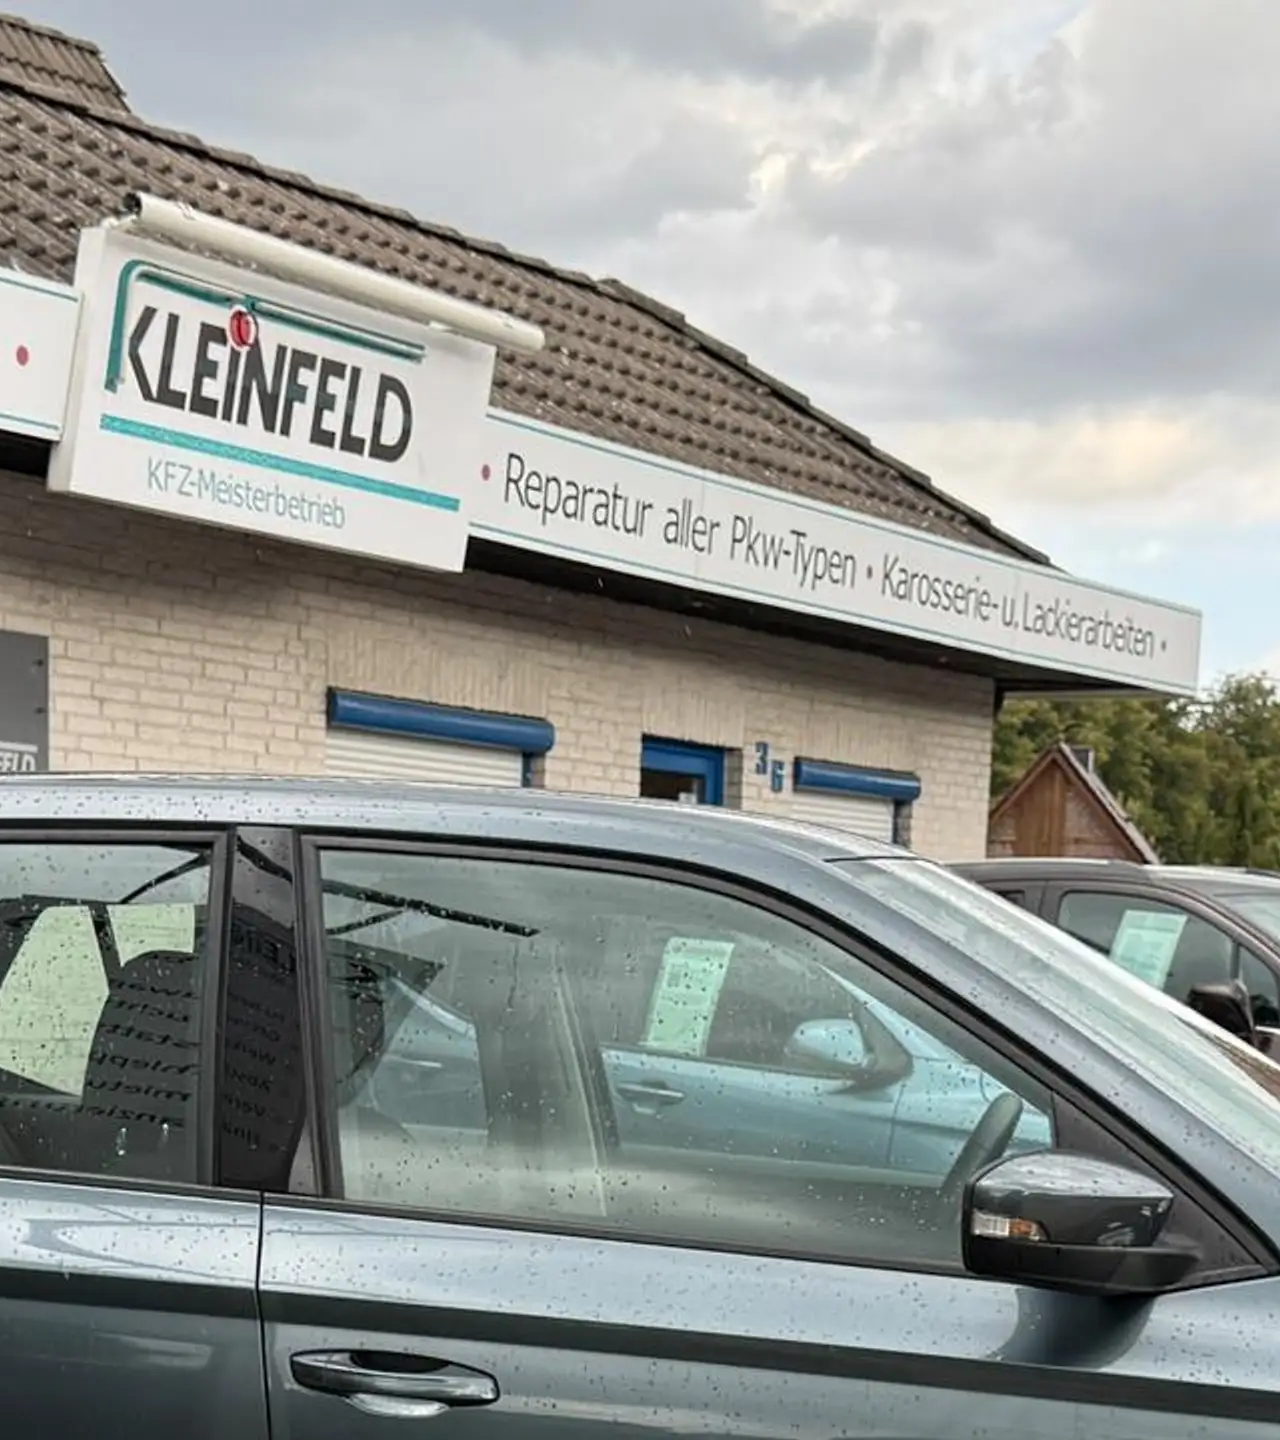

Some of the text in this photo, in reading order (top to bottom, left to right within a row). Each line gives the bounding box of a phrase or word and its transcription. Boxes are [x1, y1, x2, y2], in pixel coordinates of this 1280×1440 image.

[127, 304, 414, 464] KLEINFELD
[147, 456, 347, 530] KFZ-Meisterbetrieb
[504, 452, 654, 538] Reparatur
[663, 498, 721, 556] aller
[730, 514, 858, 591] Pkw-Typen
[1022, 591, 1156, 660] Lackierarbeiten
